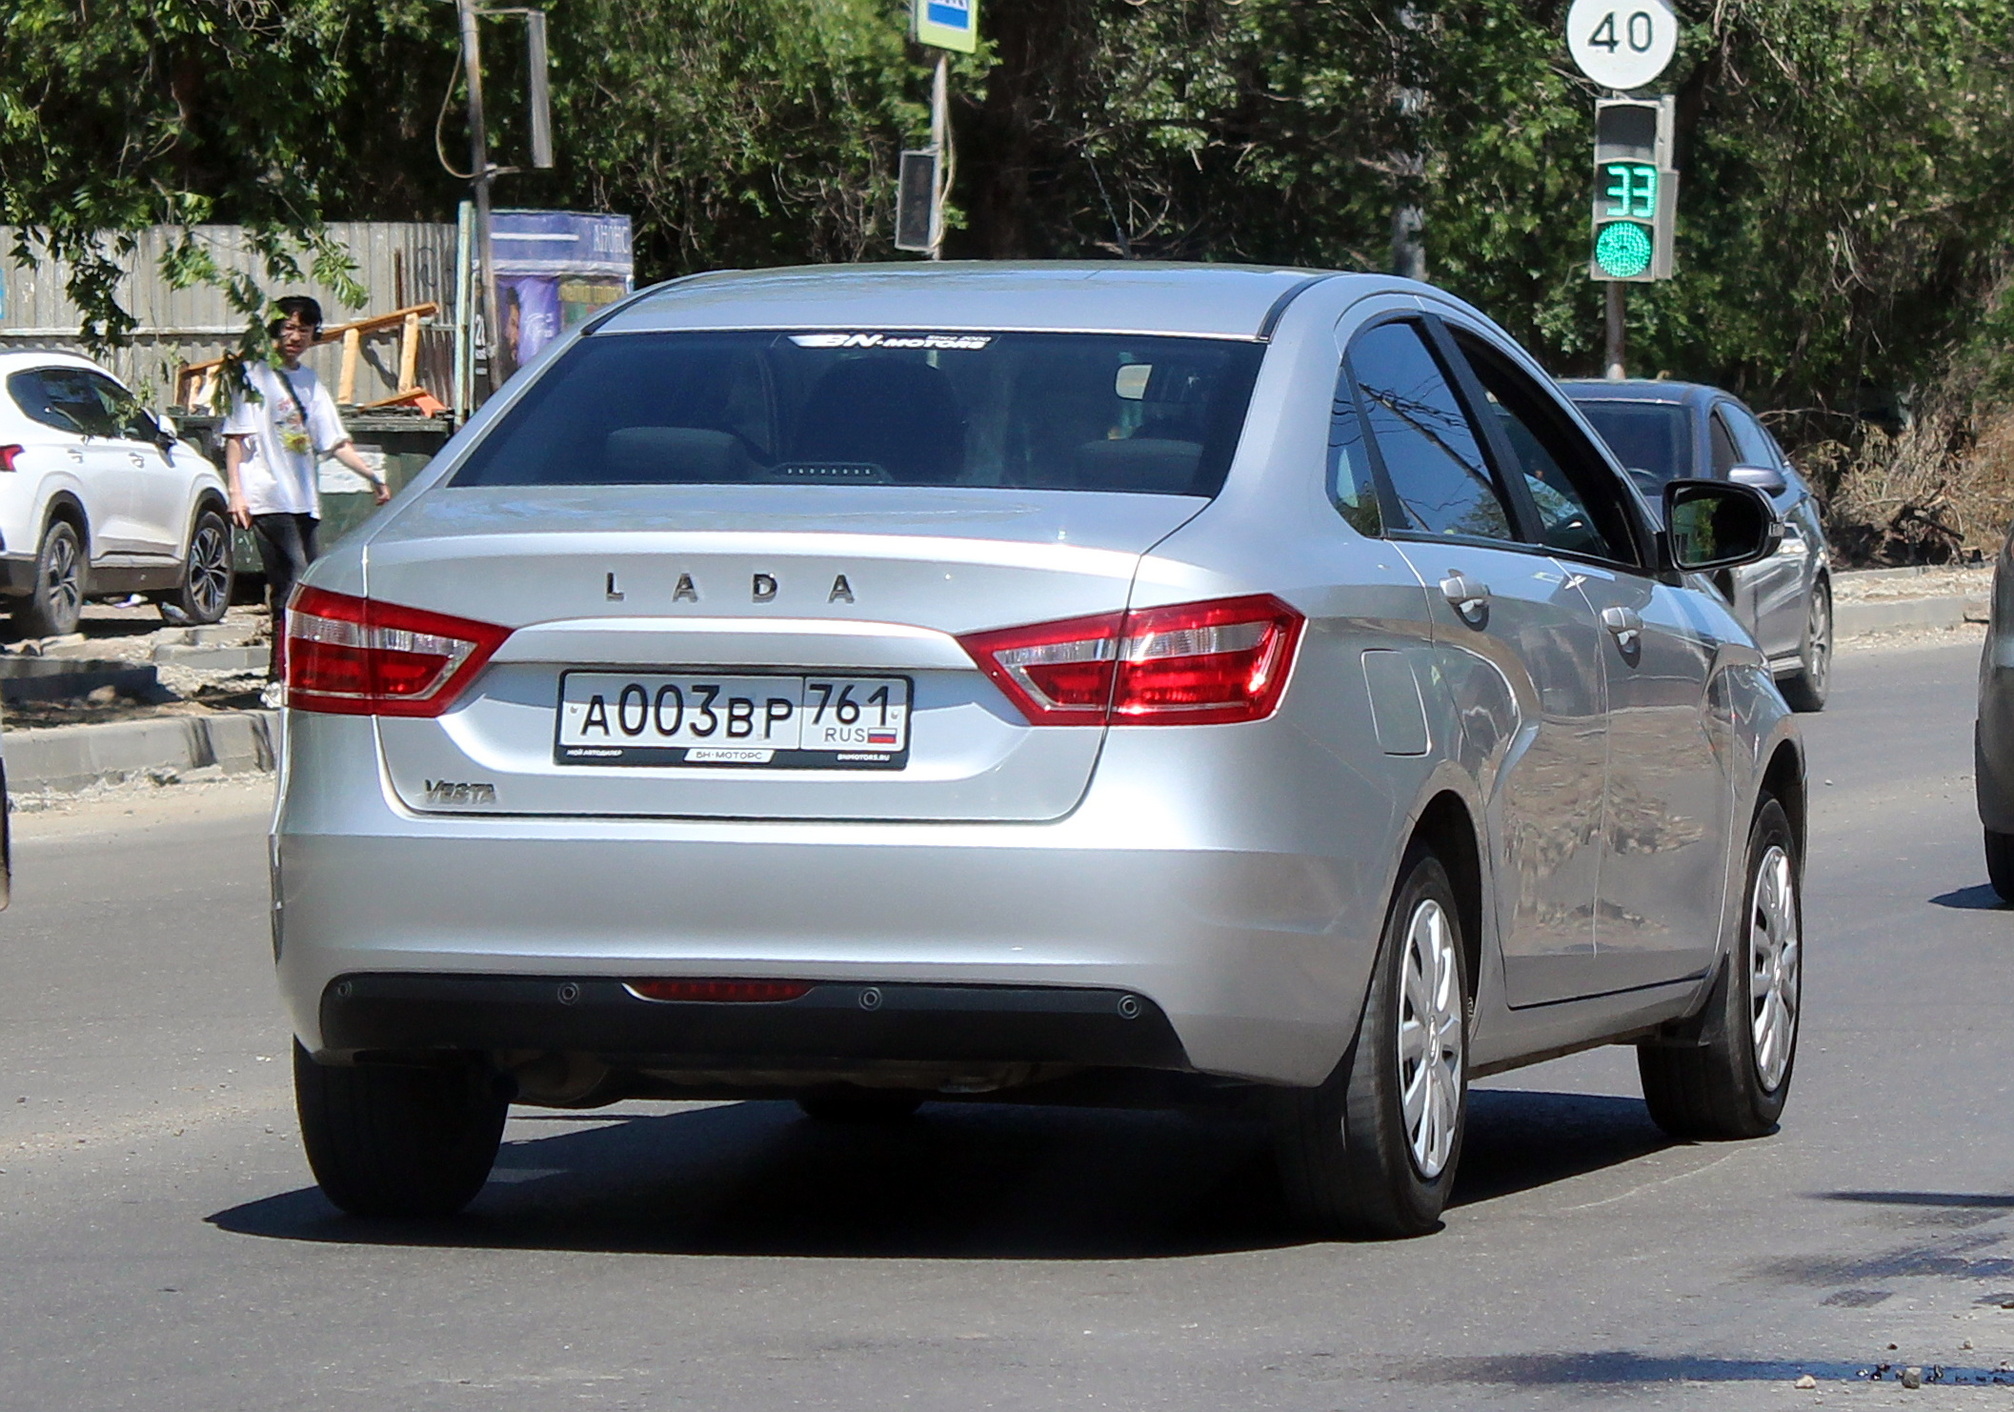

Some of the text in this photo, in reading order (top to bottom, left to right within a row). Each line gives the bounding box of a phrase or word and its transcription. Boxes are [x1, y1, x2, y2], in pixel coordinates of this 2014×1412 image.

[1588, 11, 1653, 53] 40
[1606, 165, 1657, 217] 33
[606, 572, 854, 603] LADA
[808, 684, 890, 727] 761
[824, 727, 866, 743] RUS
[425, 779, 496, 804] VESTA
